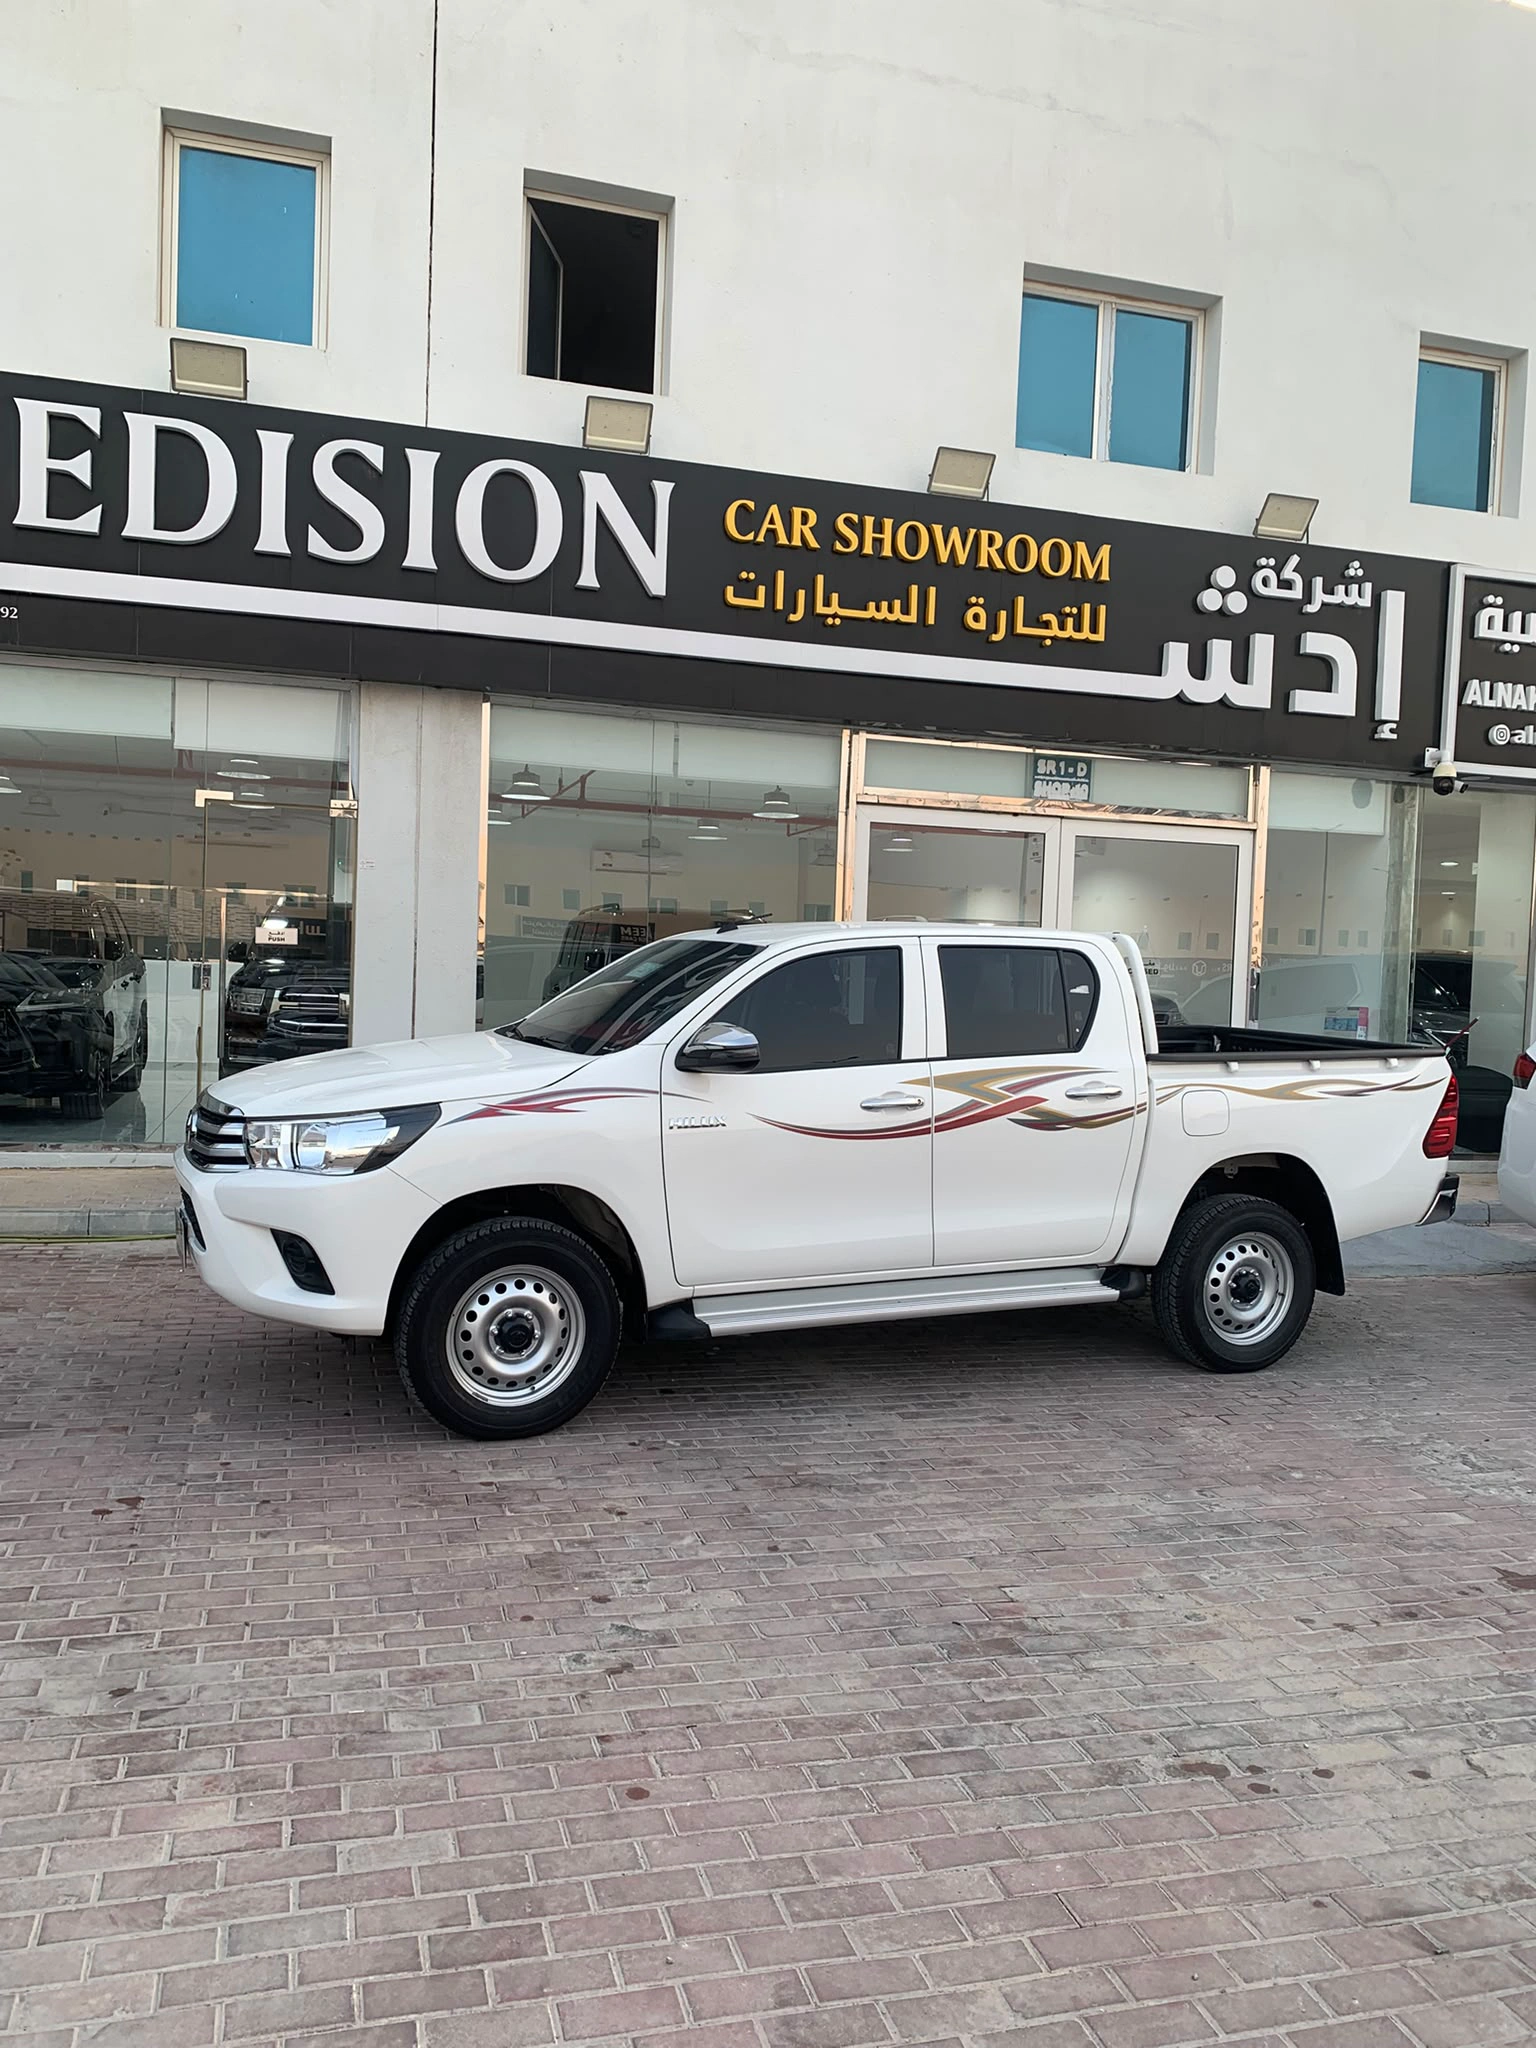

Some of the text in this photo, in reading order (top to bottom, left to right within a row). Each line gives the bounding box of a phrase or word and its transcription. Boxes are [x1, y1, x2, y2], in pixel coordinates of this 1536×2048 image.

[12, 397, 675, 599] EDISION
[724, 499, 1112, 582] CAR SHOWROOM
[0, 606, 18, 619] 92
[723, 569, 1107, 647] للتجارة السيارات
[1250, 553, 1373, 614] شركة
[669, 1116, 727, 1130] HILUX
